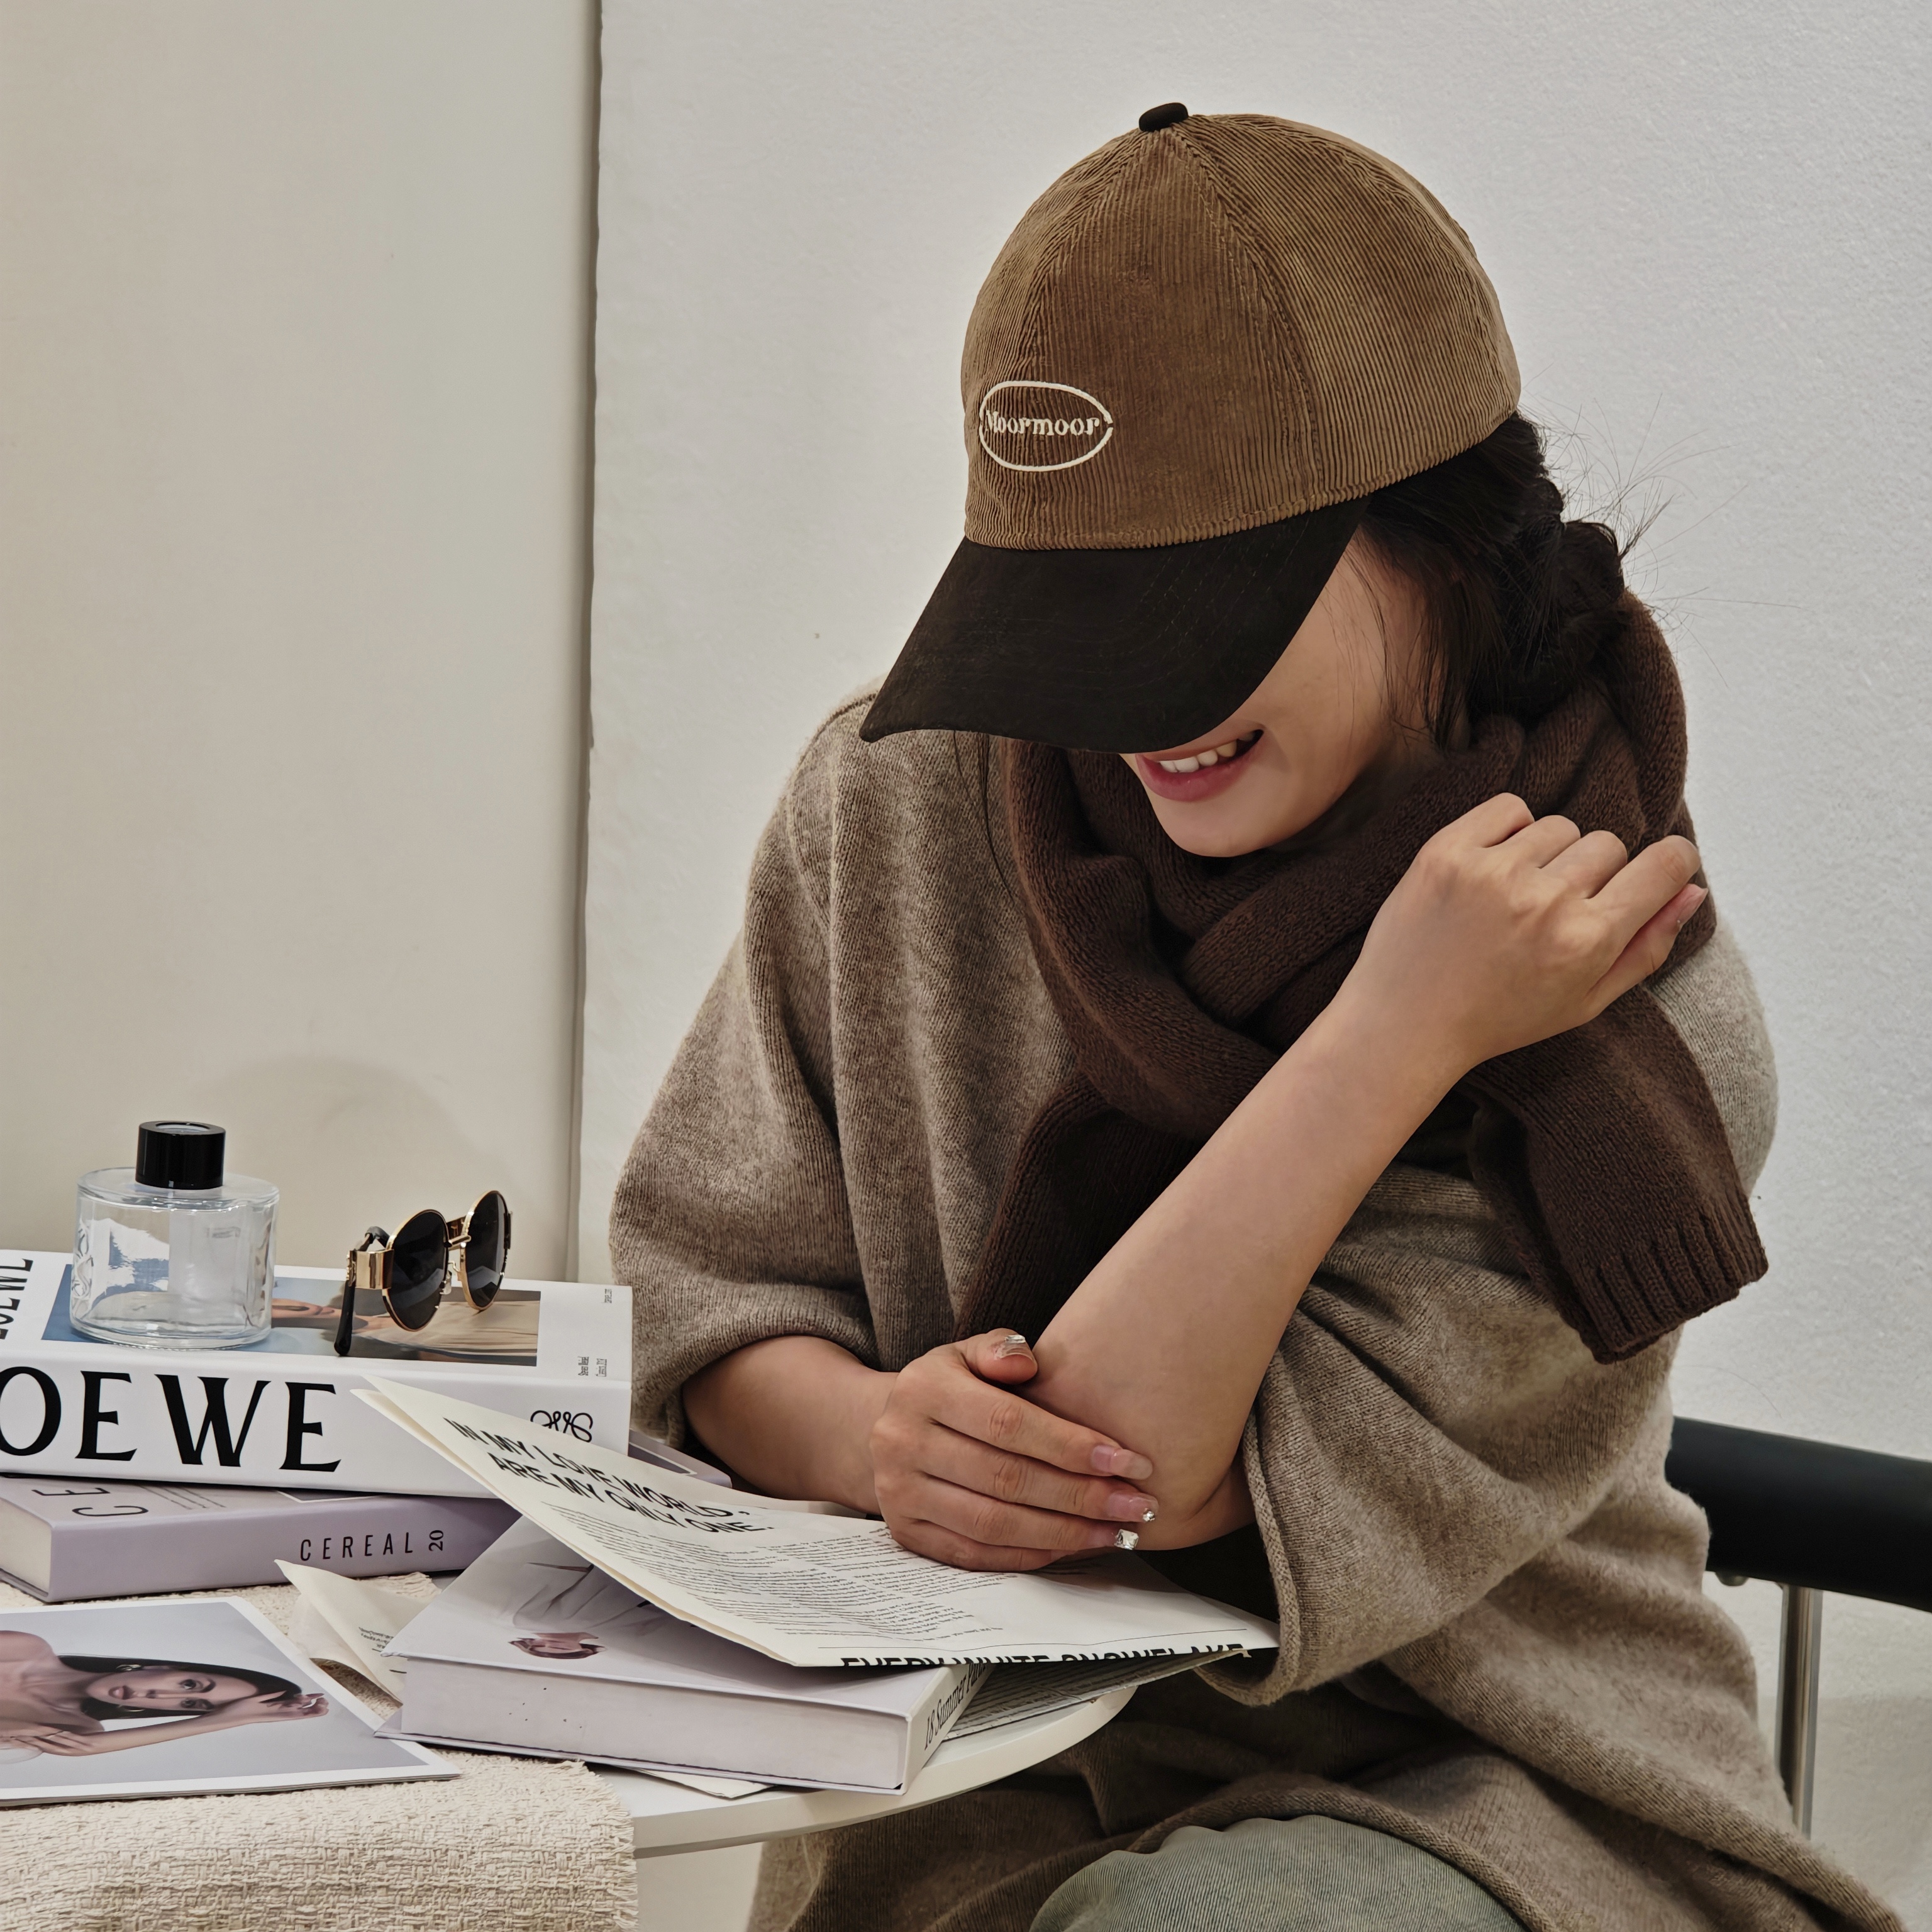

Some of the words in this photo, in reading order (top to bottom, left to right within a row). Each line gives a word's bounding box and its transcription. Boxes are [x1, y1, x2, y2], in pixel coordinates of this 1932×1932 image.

[442, 1417, 490, 1445] IN
[480, 1430, 536, 1460] MY
[532, 1445, 624, 1492] LOVE
[487, 1452, 560, 1489] ARE
[550, 1473, 605, 1503] MY
[604, 1490, 688, 1528] ONLY
[684, 1518, 775, 1533] ONE.
[300, 1532, 413, 1561] CEREAL
[428, 1530, 444, 1552] 20
[935, 1674, 967, 1736] Summer
